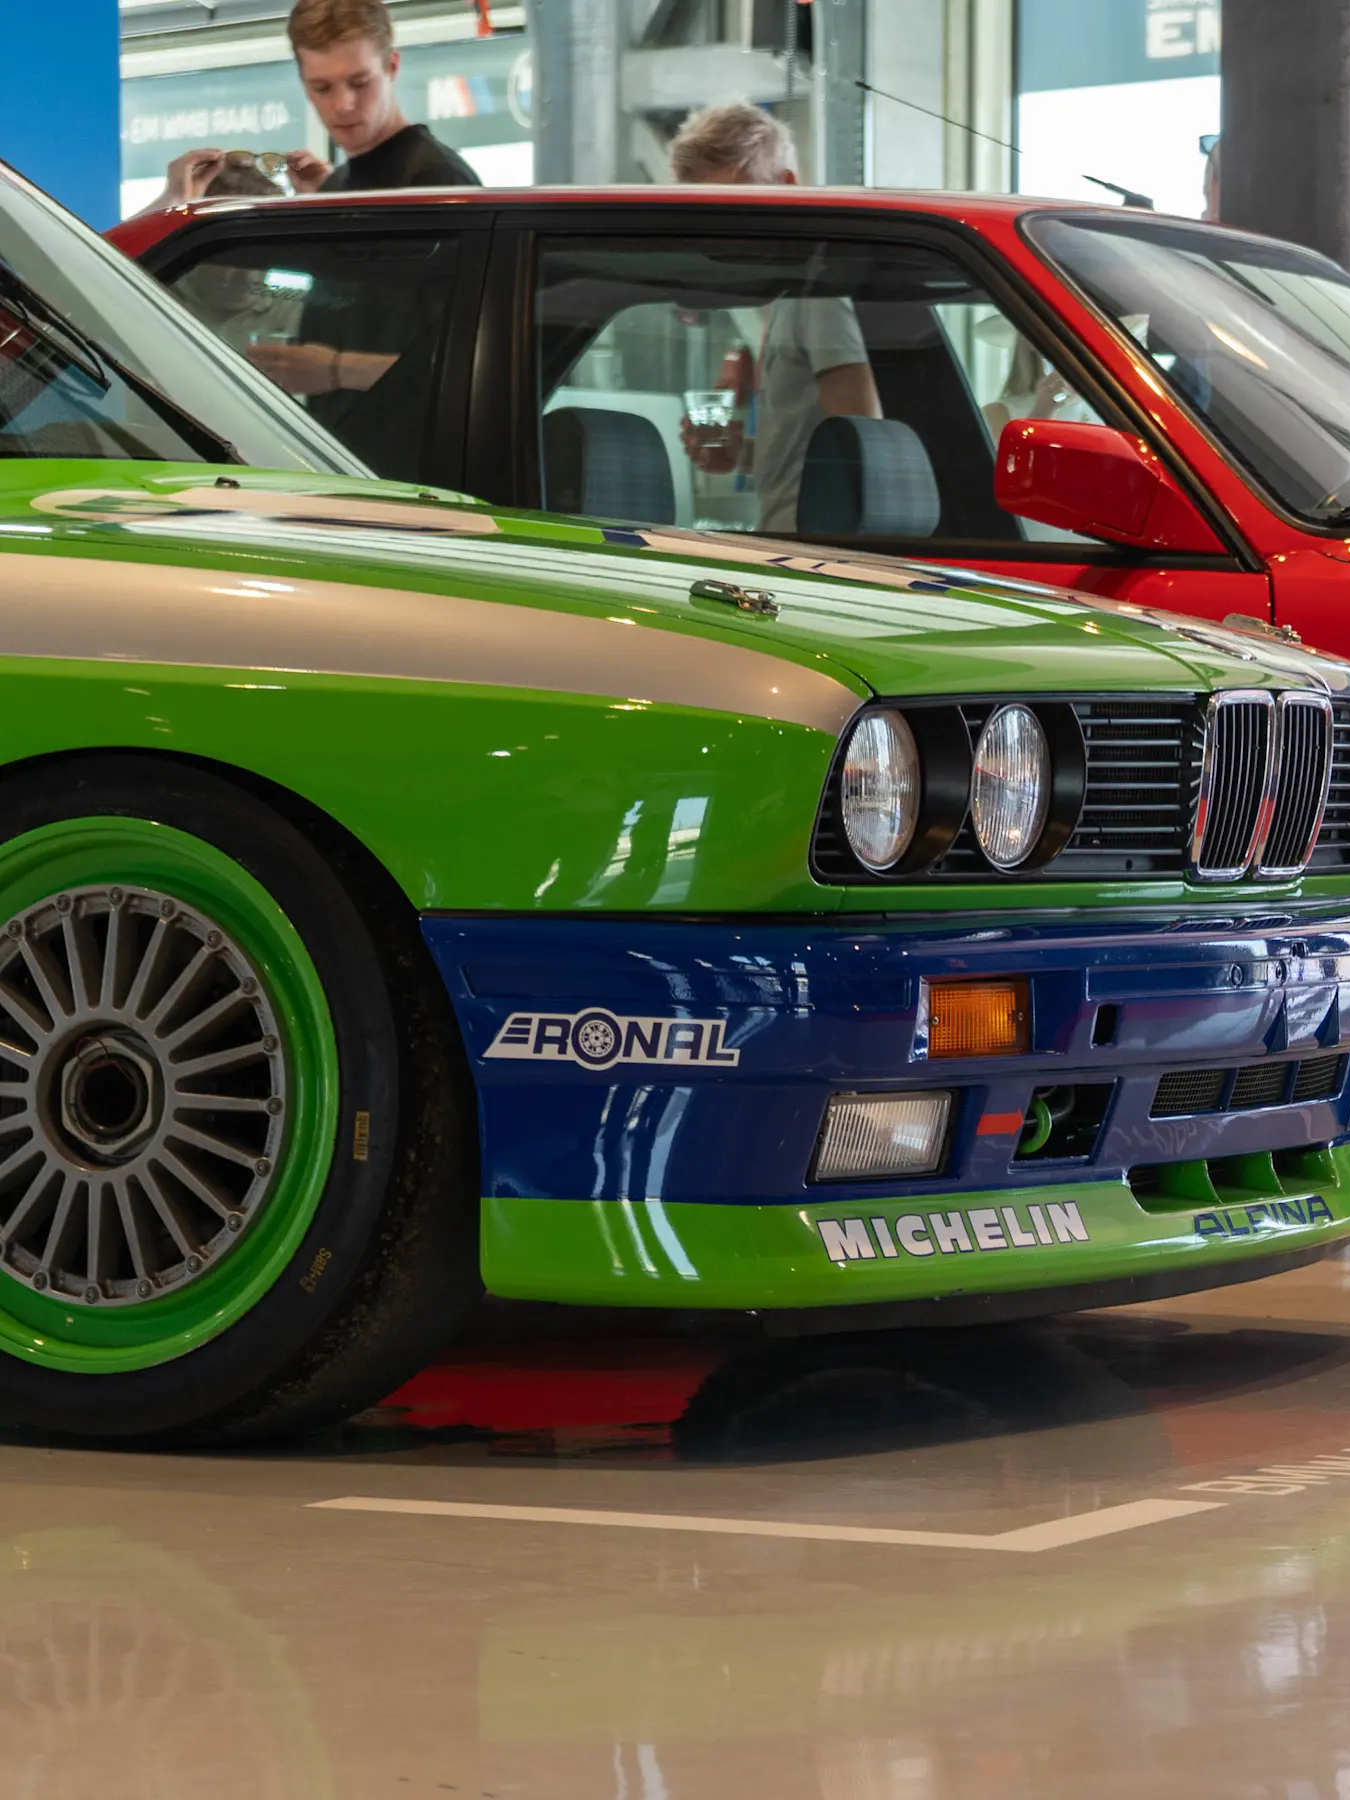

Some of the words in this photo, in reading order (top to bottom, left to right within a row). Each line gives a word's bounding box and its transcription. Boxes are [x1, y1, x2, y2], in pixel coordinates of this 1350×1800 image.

[533, 1008, 737, 1067] RONAL
[816, 1201, 1089, 1261] MICHELIN
[1193, 1196, 1334, 1238] ALPINA
